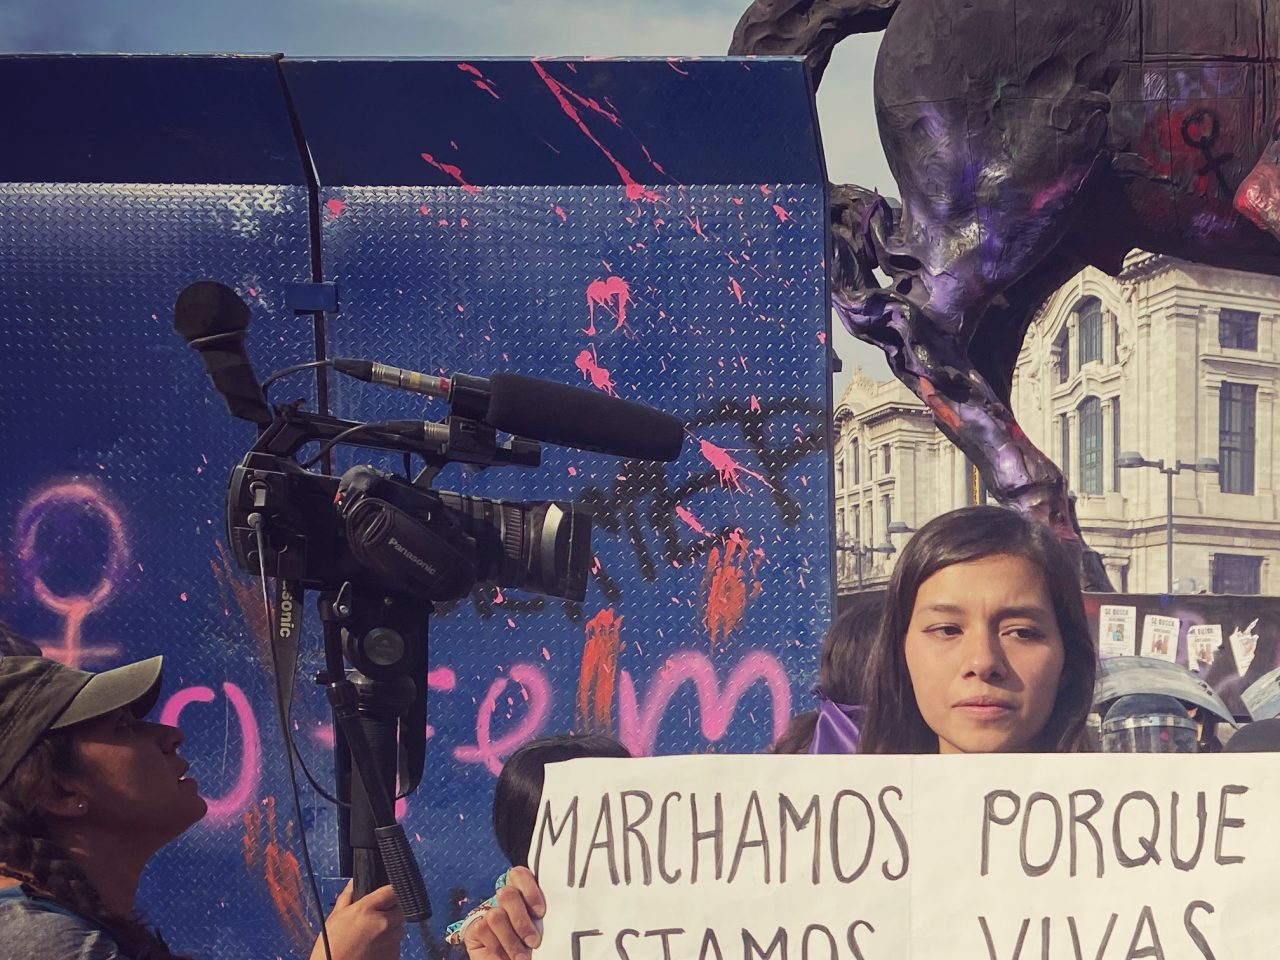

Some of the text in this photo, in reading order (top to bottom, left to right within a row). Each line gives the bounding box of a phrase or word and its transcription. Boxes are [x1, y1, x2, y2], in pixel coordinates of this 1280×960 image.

[388, 537, 437, 576] Panasonic
[532, 783, 1249, 889] MARCHAMOS PORQUE
